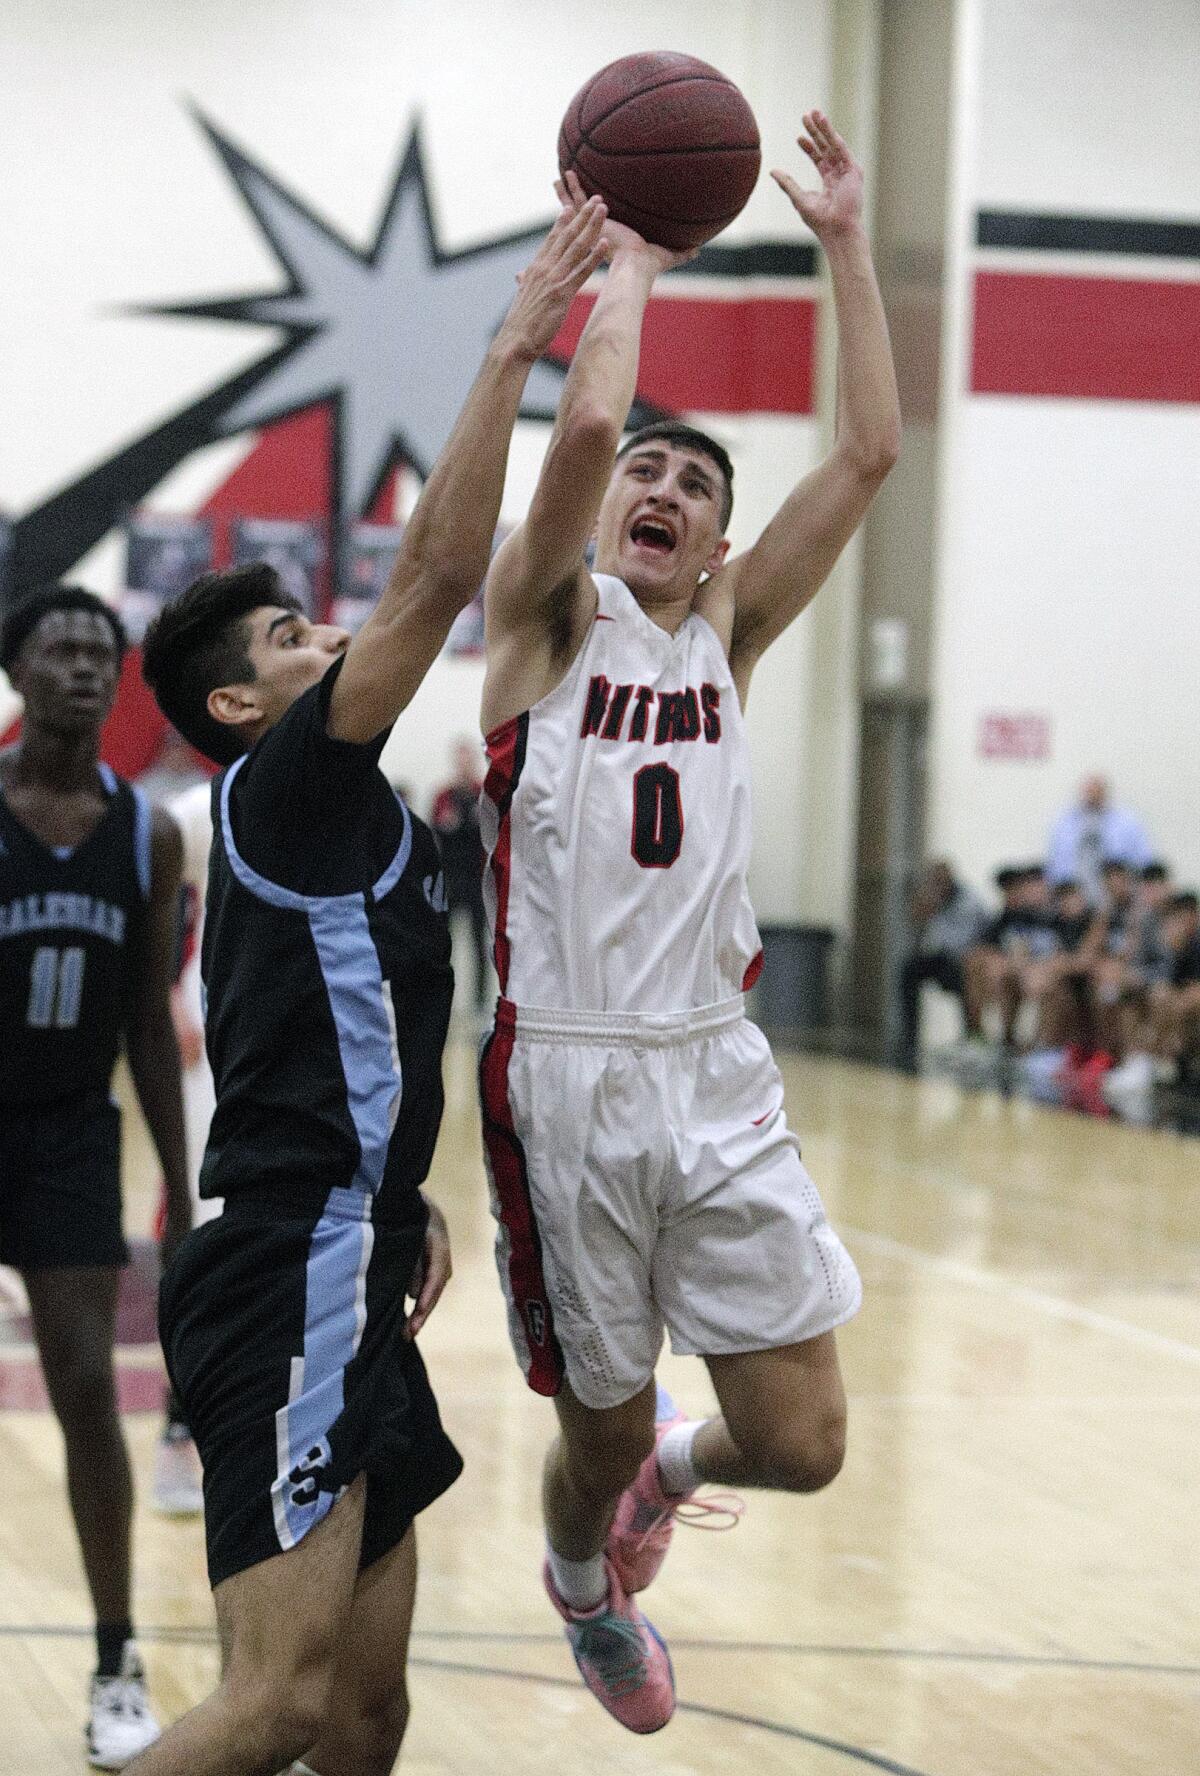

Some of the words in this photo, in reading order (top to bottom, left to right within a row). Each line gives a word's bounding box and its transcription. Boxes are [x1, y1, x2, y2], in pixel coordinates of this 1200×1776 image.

[580, 674, 722, 746] NITROS
[630, 762, 684, 868] 0
[27, 946, 86, 1028] 11
